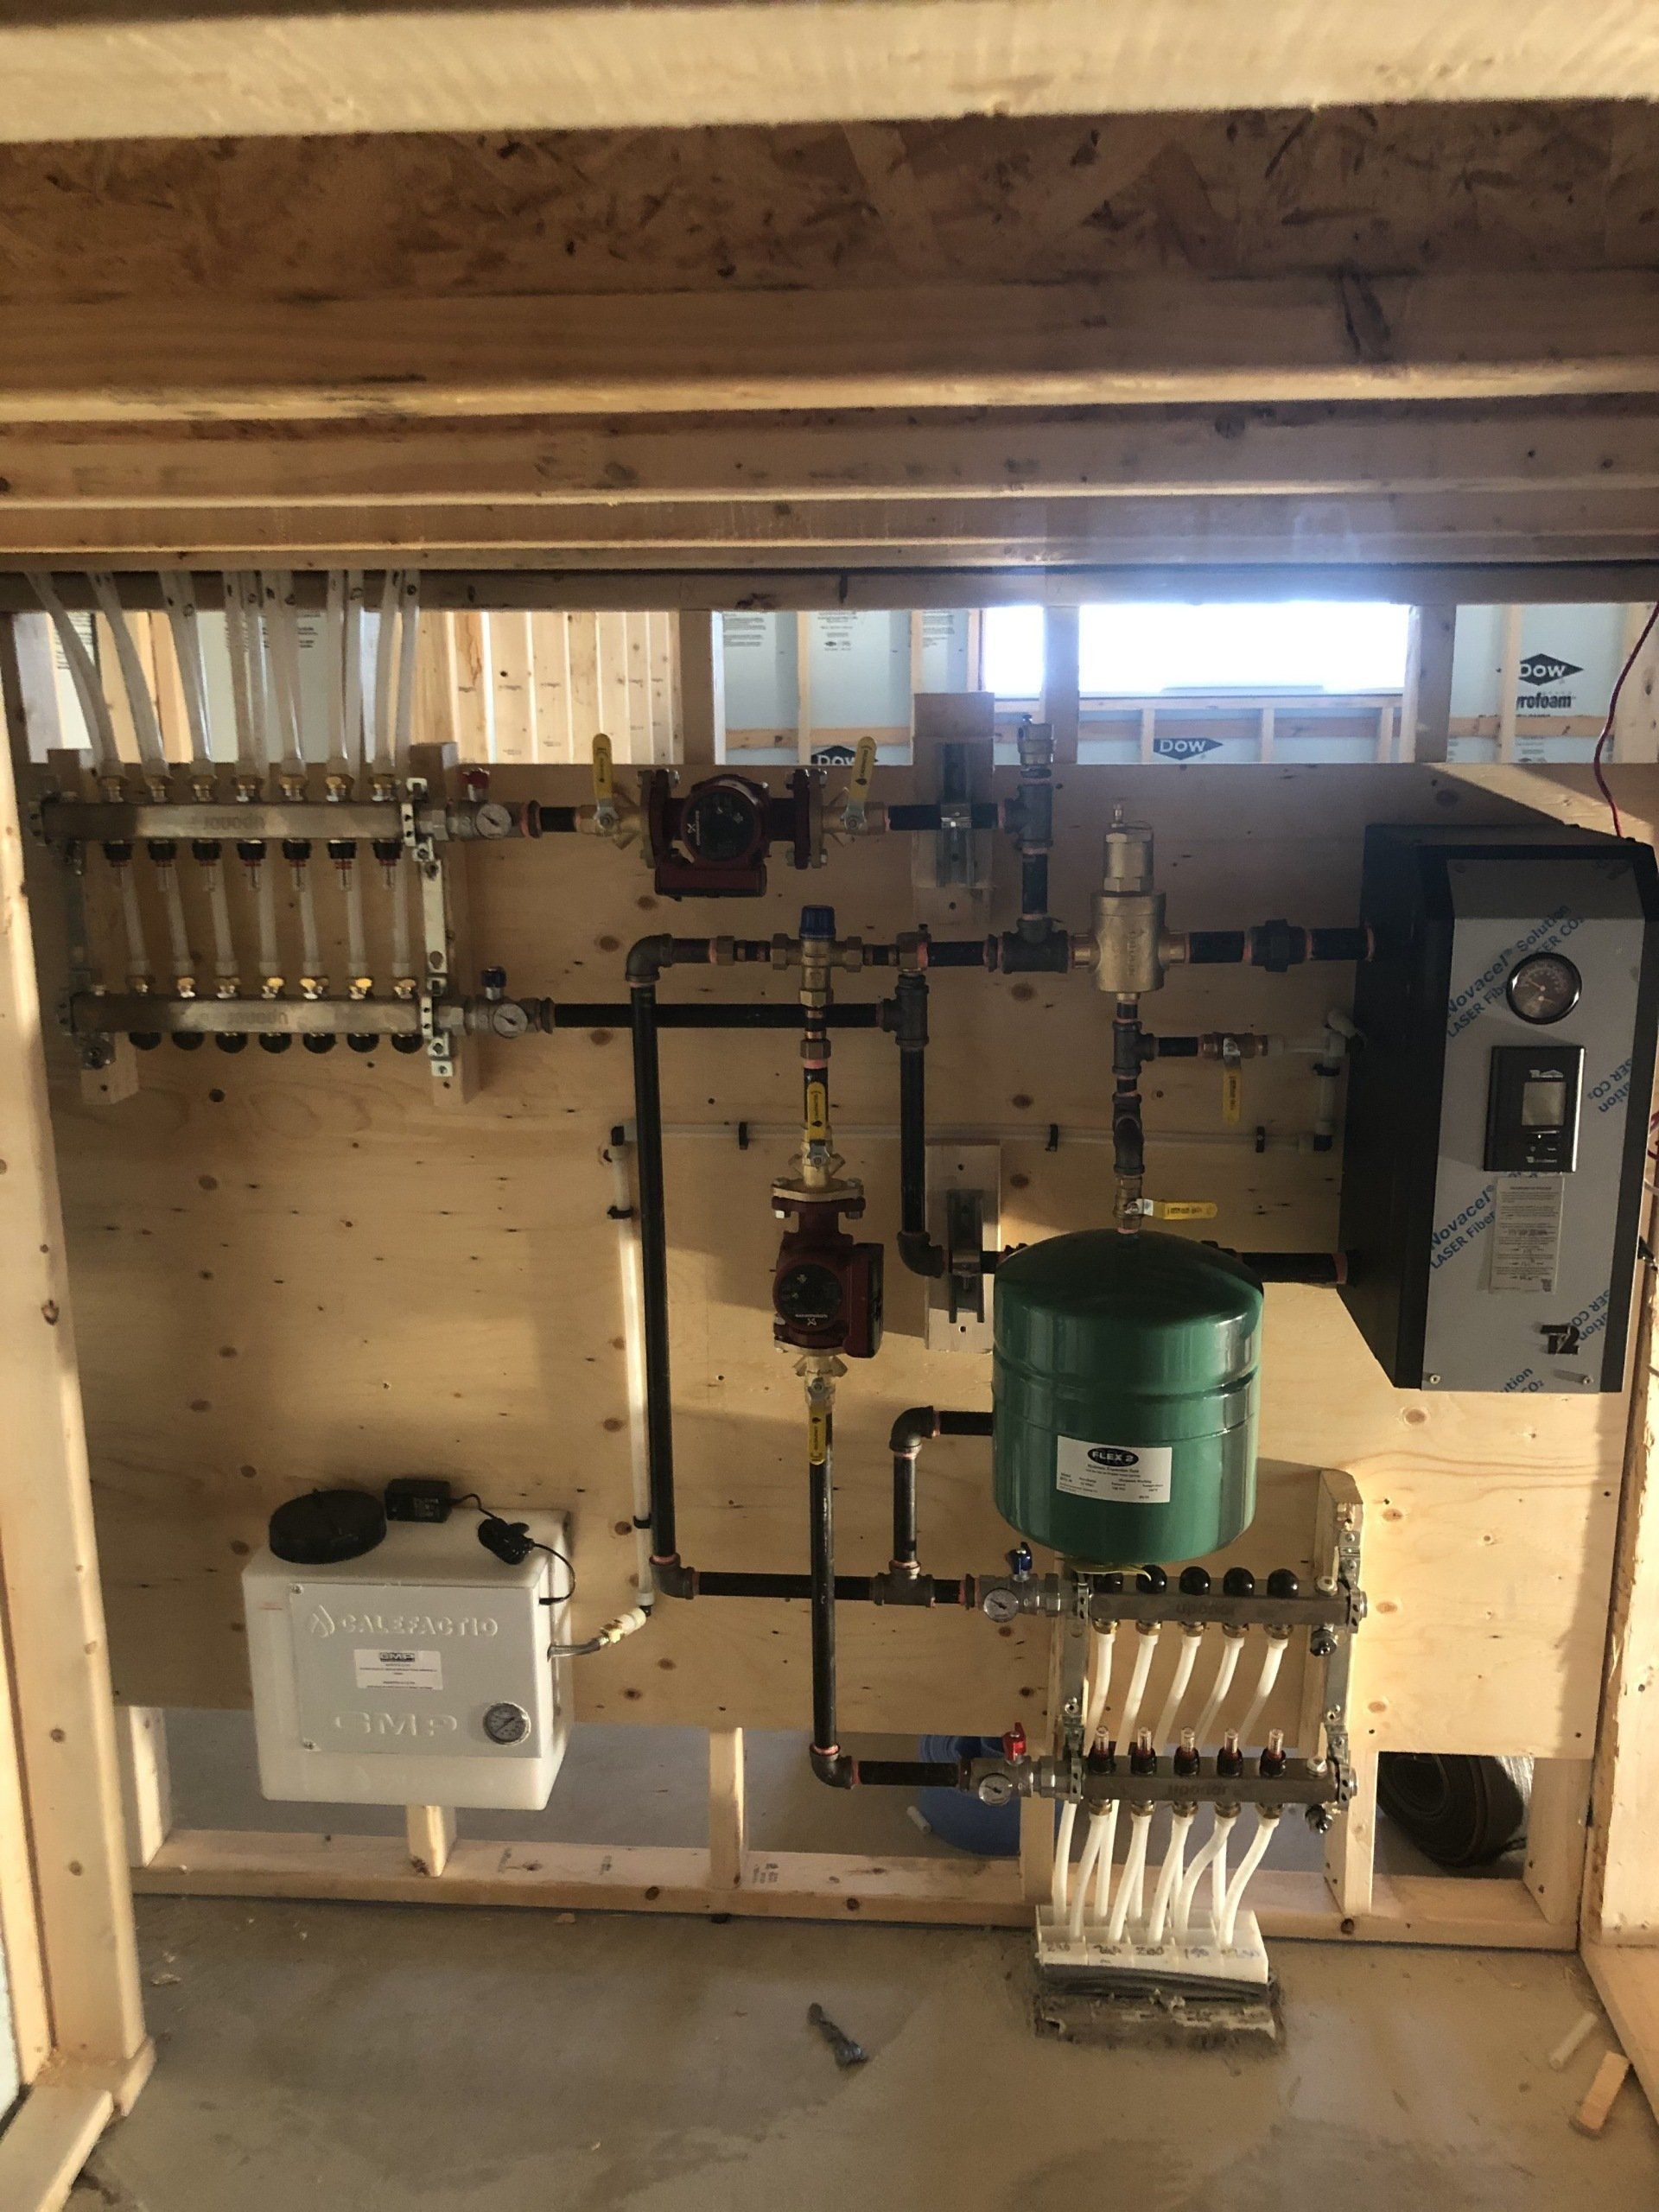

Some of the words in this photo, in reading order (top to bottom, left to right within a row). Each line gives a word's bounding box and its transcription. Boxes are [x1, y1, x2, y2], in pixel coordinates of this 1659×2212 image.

[1520, 664, 1566, 678] DOW
[1160, 739, 1206, 753] DOW
[1447, 1002, 1485, 1037] LASER
[1430, 1236, 1468, 1268] LASER
[1465, 1211, 1495, 1238] Fiber
[1540, 1325, 1580, 1355] T2
[1092, 1451, 1122, 1462] FLEX
[342, 1614, 499, 1636] CALEFACTIO
